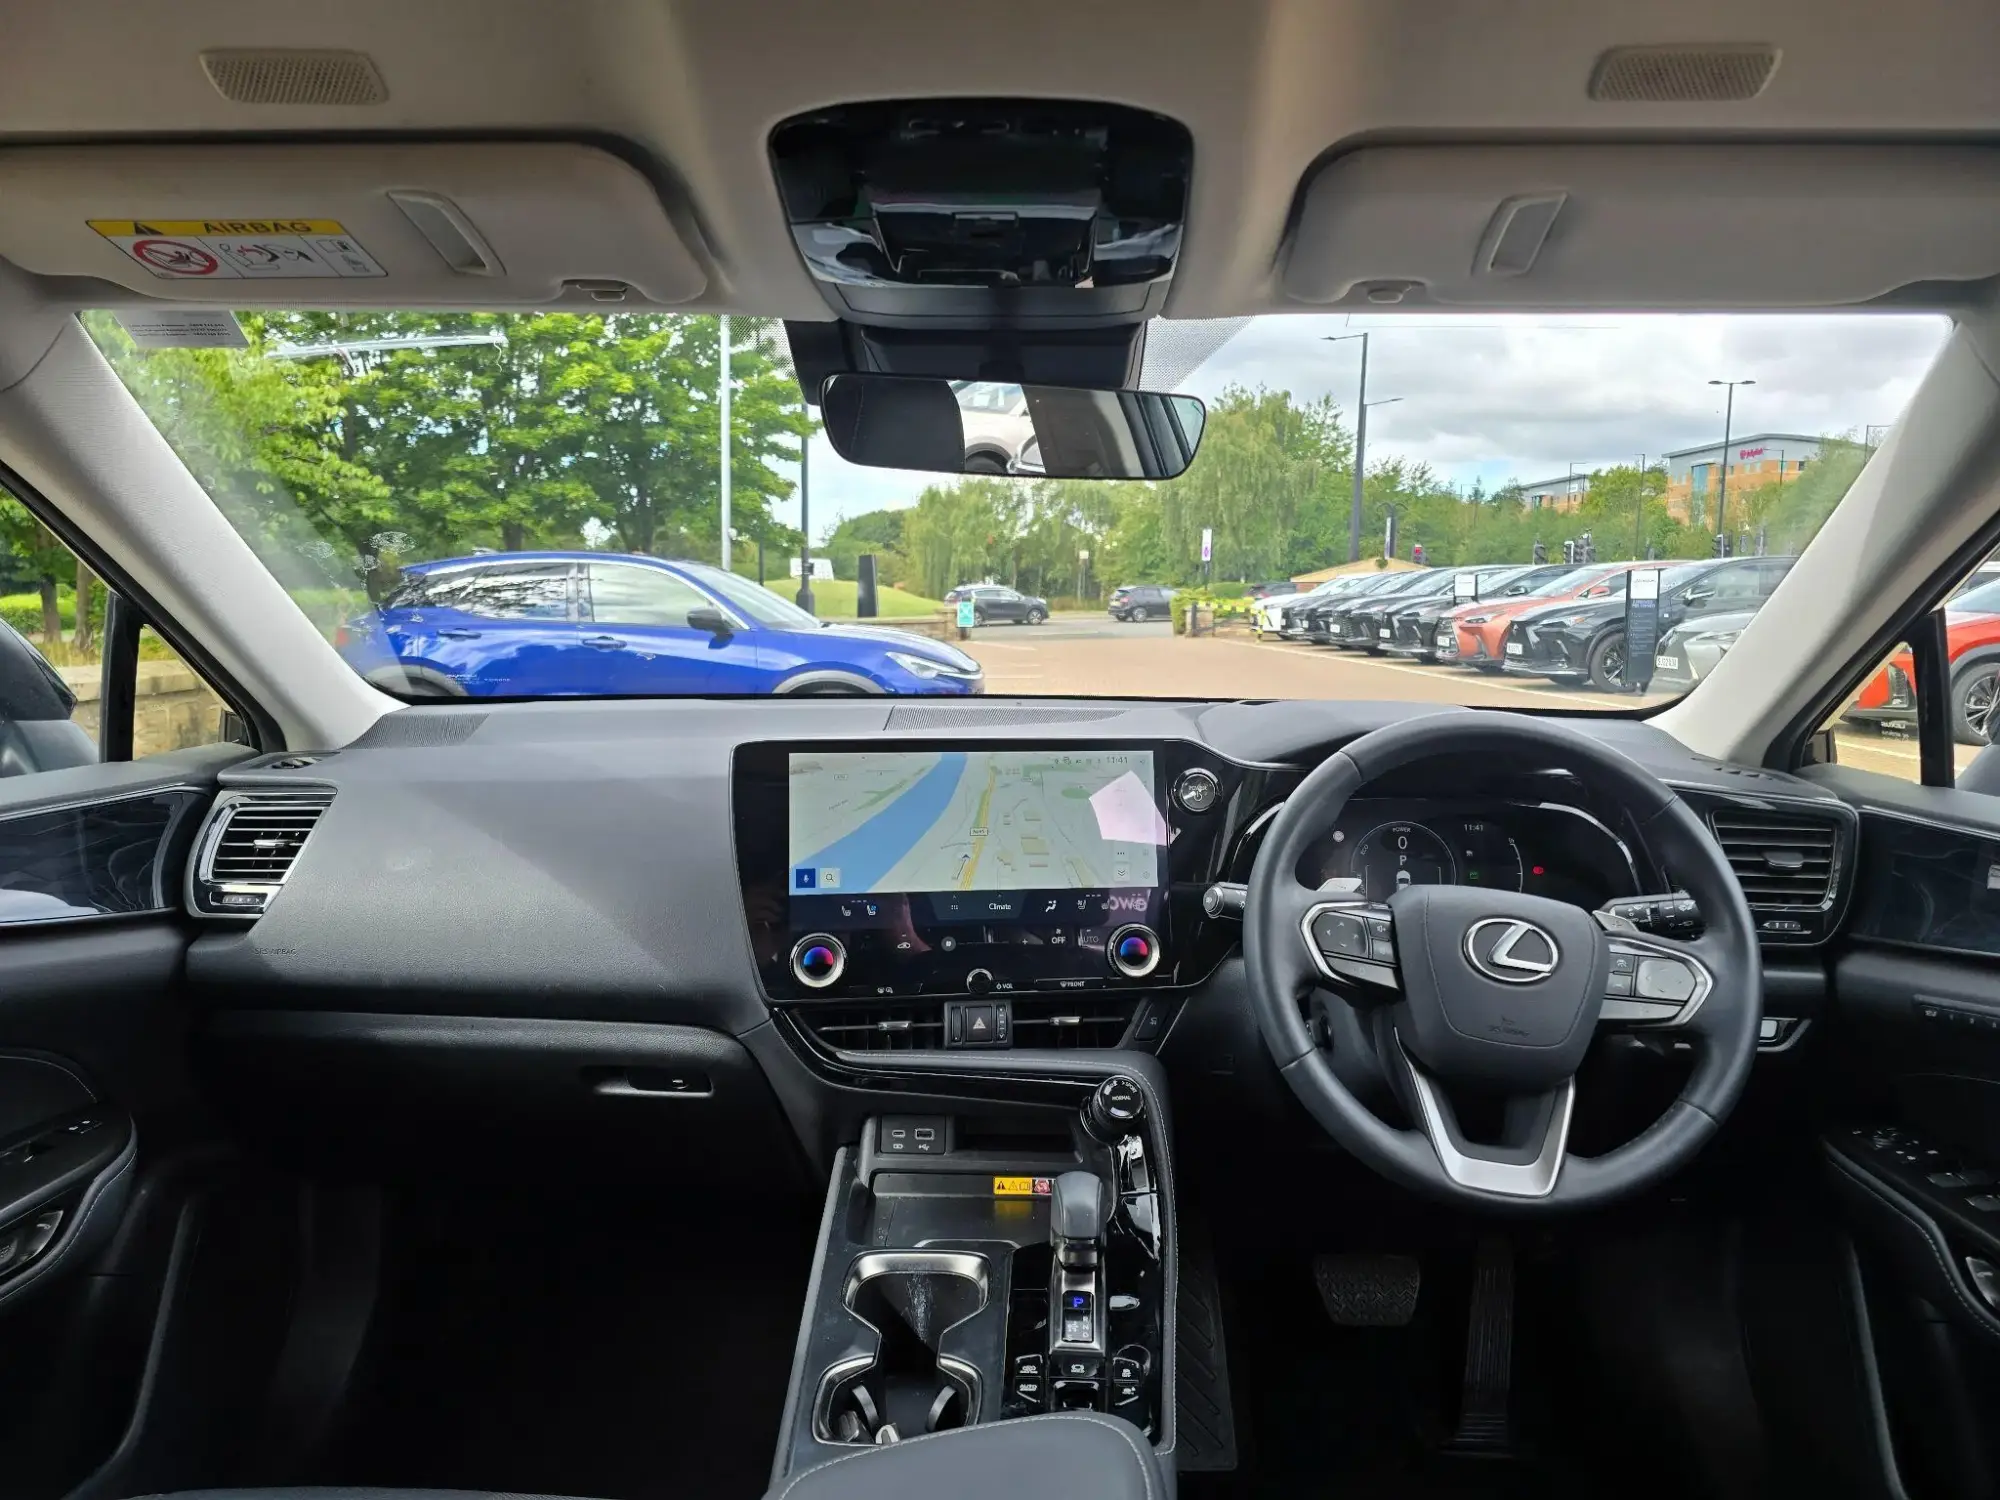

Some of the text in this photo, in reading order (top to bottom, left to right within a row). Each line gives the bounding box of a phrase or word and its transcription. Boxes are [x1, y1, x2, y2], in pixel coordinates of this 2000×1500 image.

[205, 222, 312, 234] AIRBAG
[1107, 756, 1128, 764] 11:41
[1397, 836, 1408, 850] 0
[1400, 855, 1407, 866] P
[988, 902, 1012, 910] Climate
[1051, 936, 1066, 944] OFF
[1073, 1296, 1084, 1307] P
